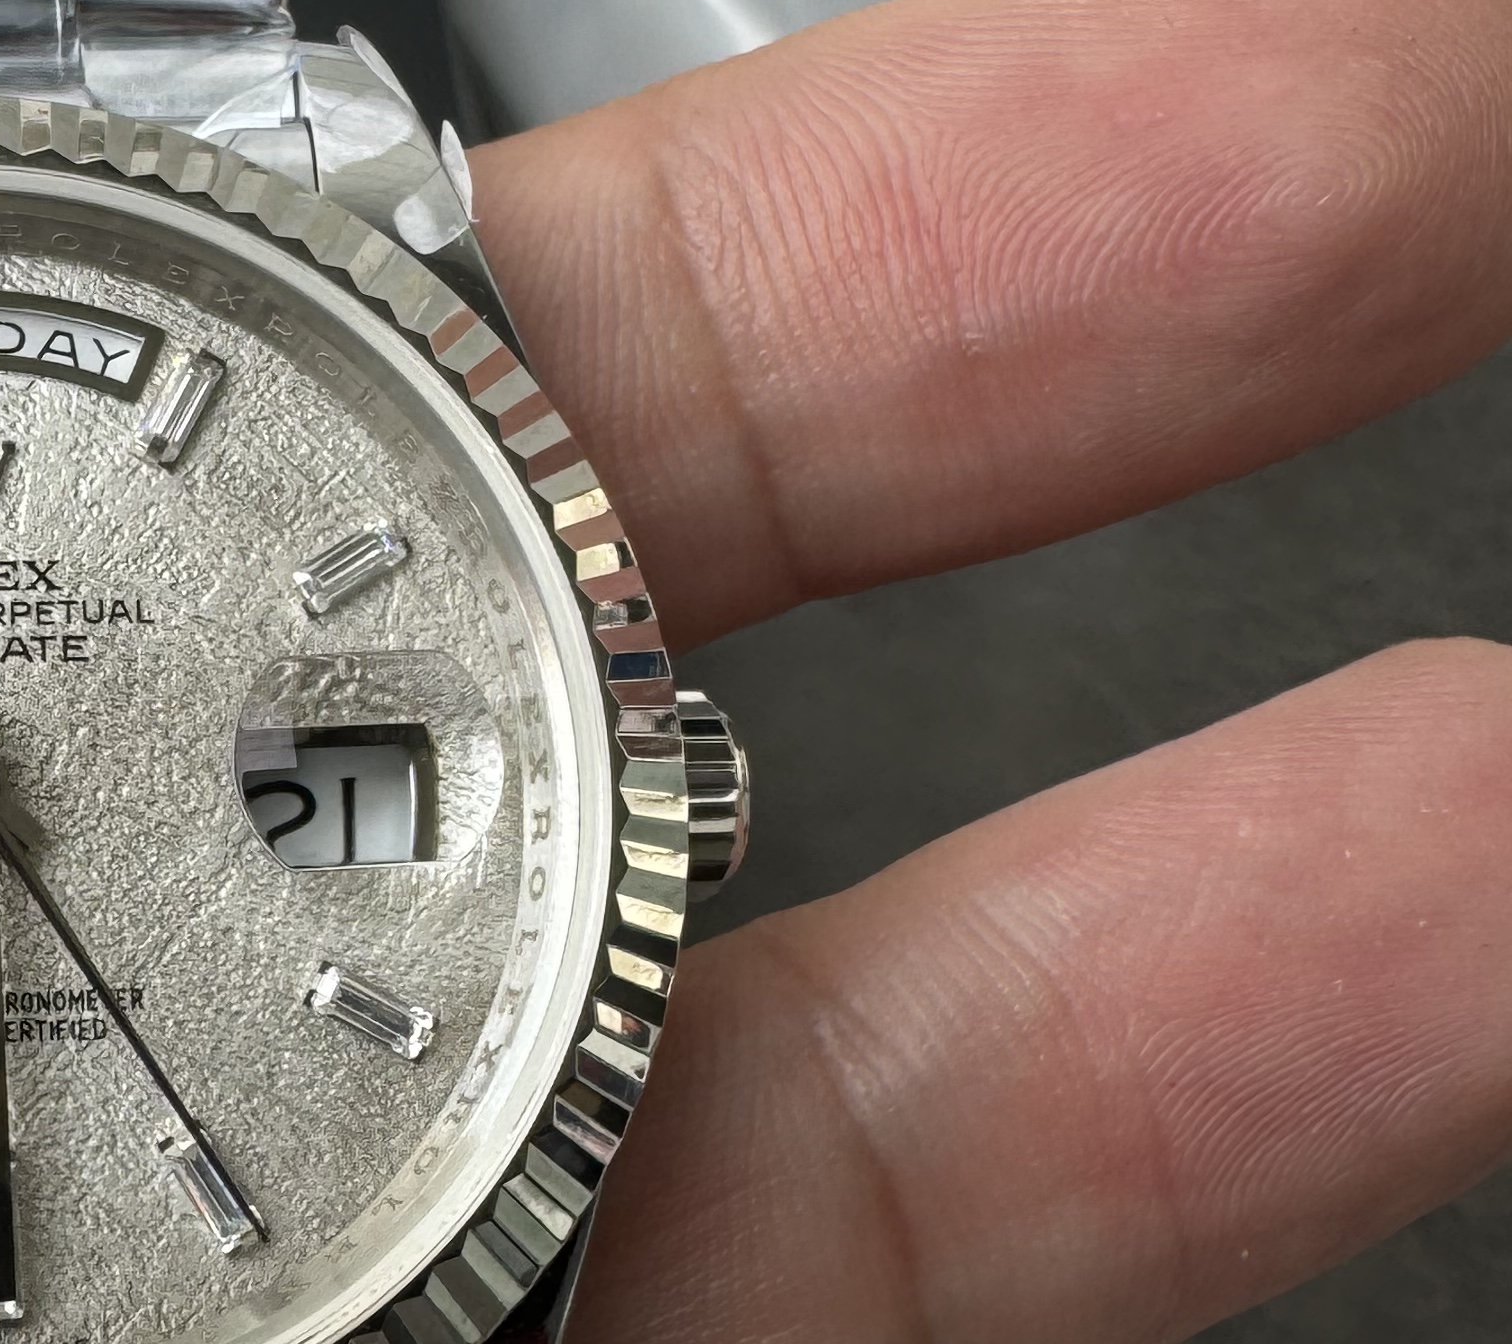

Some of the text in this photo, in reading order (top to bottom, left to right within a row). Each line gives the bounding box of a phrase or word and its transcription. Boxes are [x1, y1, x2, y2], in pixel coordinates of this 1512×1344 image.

[243, 778, 356, 864] 21
[4, 987, 145, 1015] RONOMEER
[4, 1018, 107, 1044] ERTIFIED
